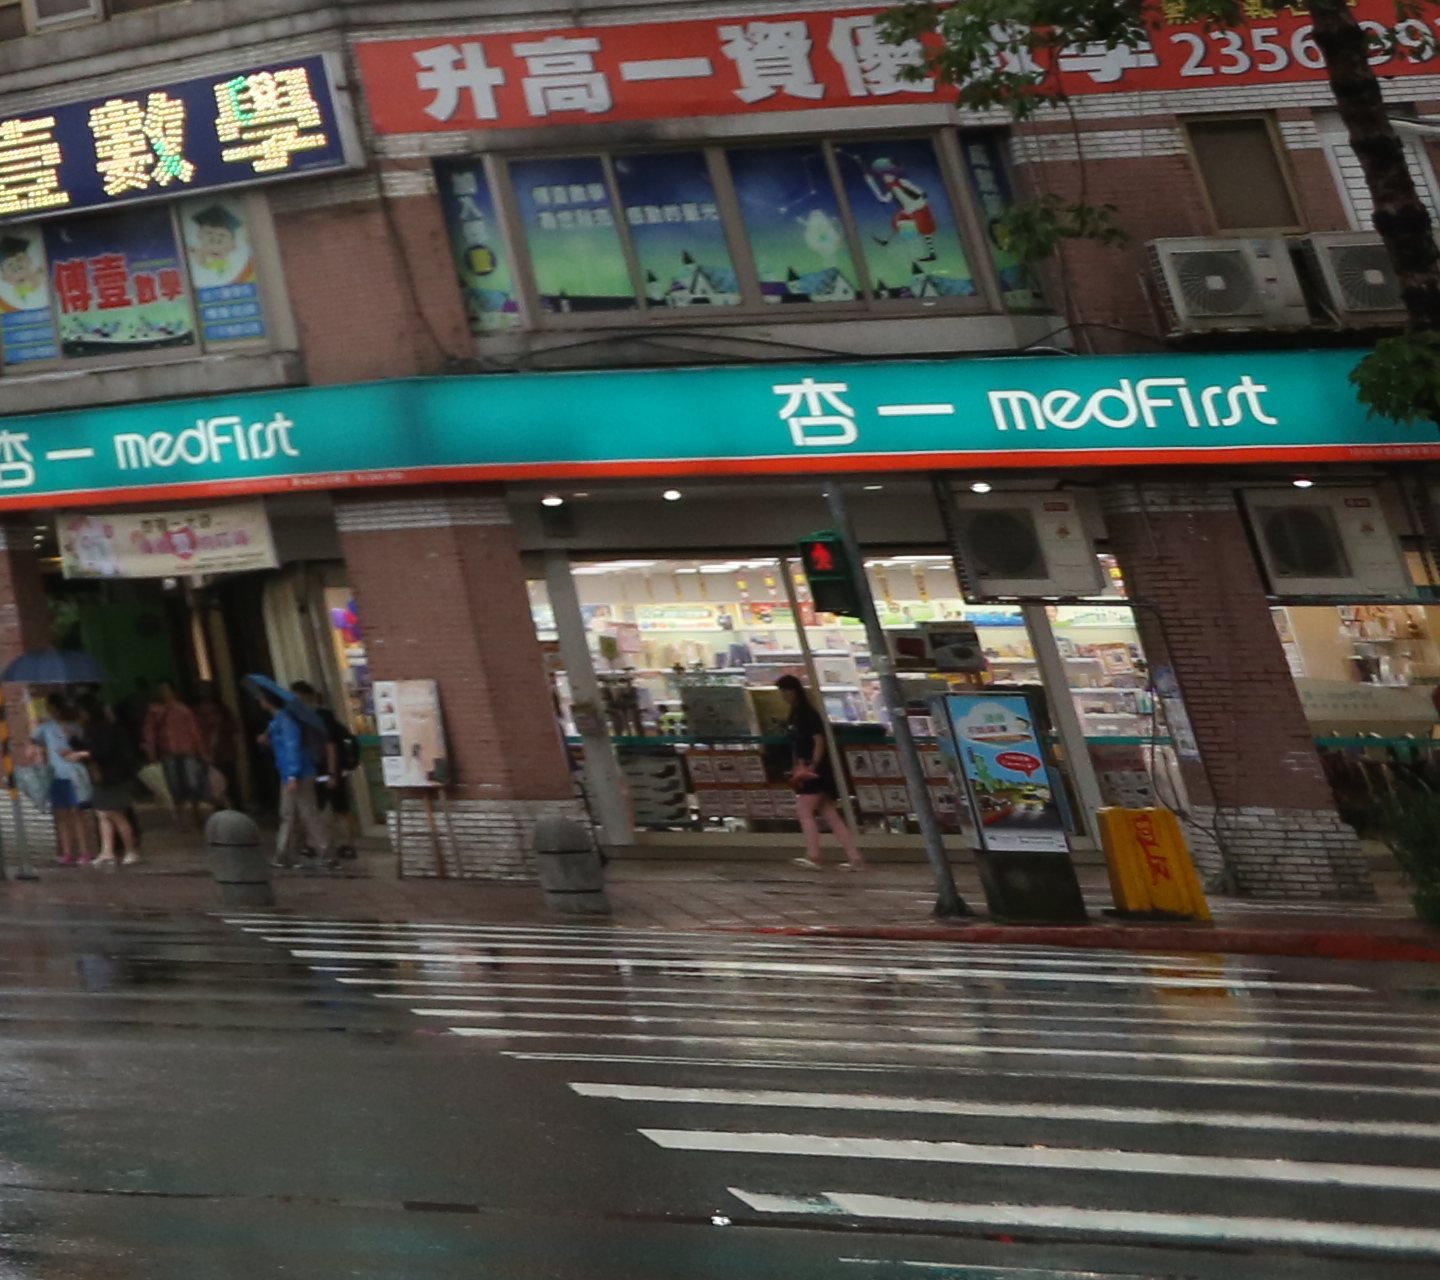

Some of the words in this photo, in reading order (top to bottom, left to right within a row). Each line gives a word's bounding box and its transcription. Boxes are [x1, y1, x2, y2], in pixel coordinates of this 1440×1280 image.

[114, 412, 300, 471] medFirst
[772, 378, 955, 447] 杏一
[988, 376, 1278, 432] medFirst
